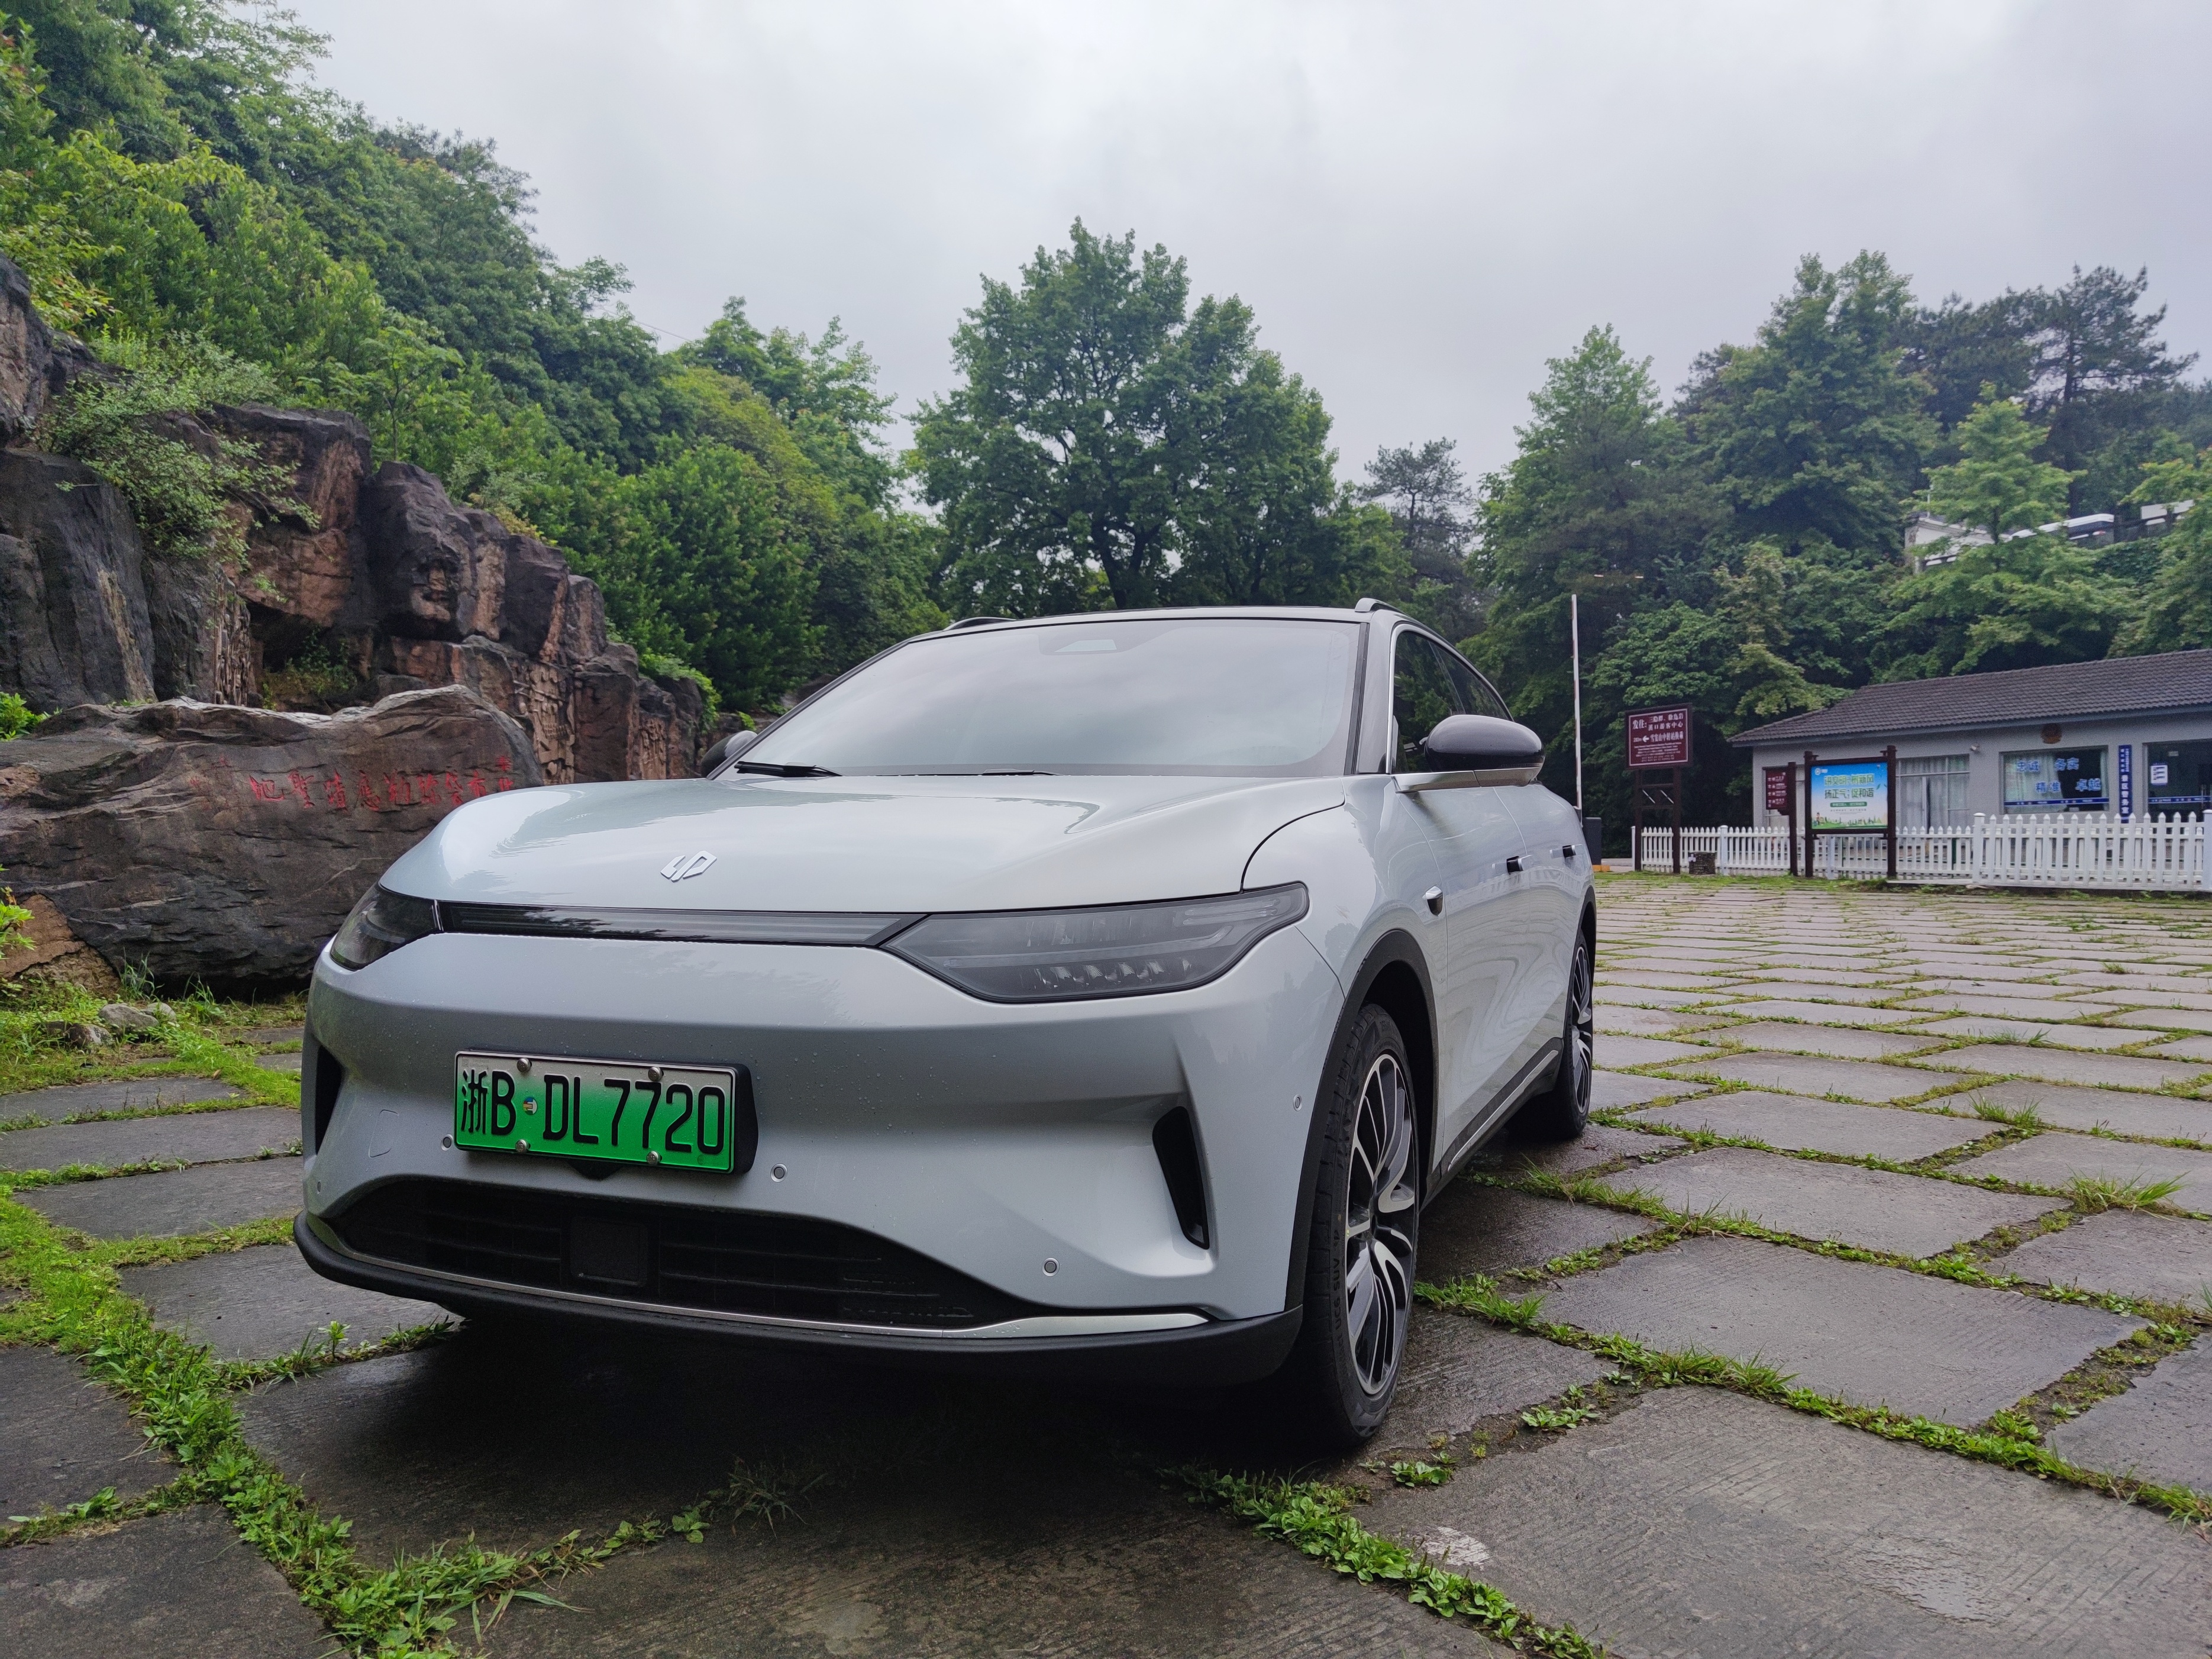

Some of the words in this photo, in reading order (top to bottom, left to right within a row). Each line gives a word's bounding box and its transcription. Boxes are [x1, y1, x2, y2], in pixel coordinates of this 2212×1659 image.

[2016, 759, 2041, 772] 忠诚
[2054, 757, 2079, 771] 务实
[2035, 780, 2061, 793] 精准
[2075, 777, 2101, 792] 卓越
[542, 1074, 725, 1154] DL7720
